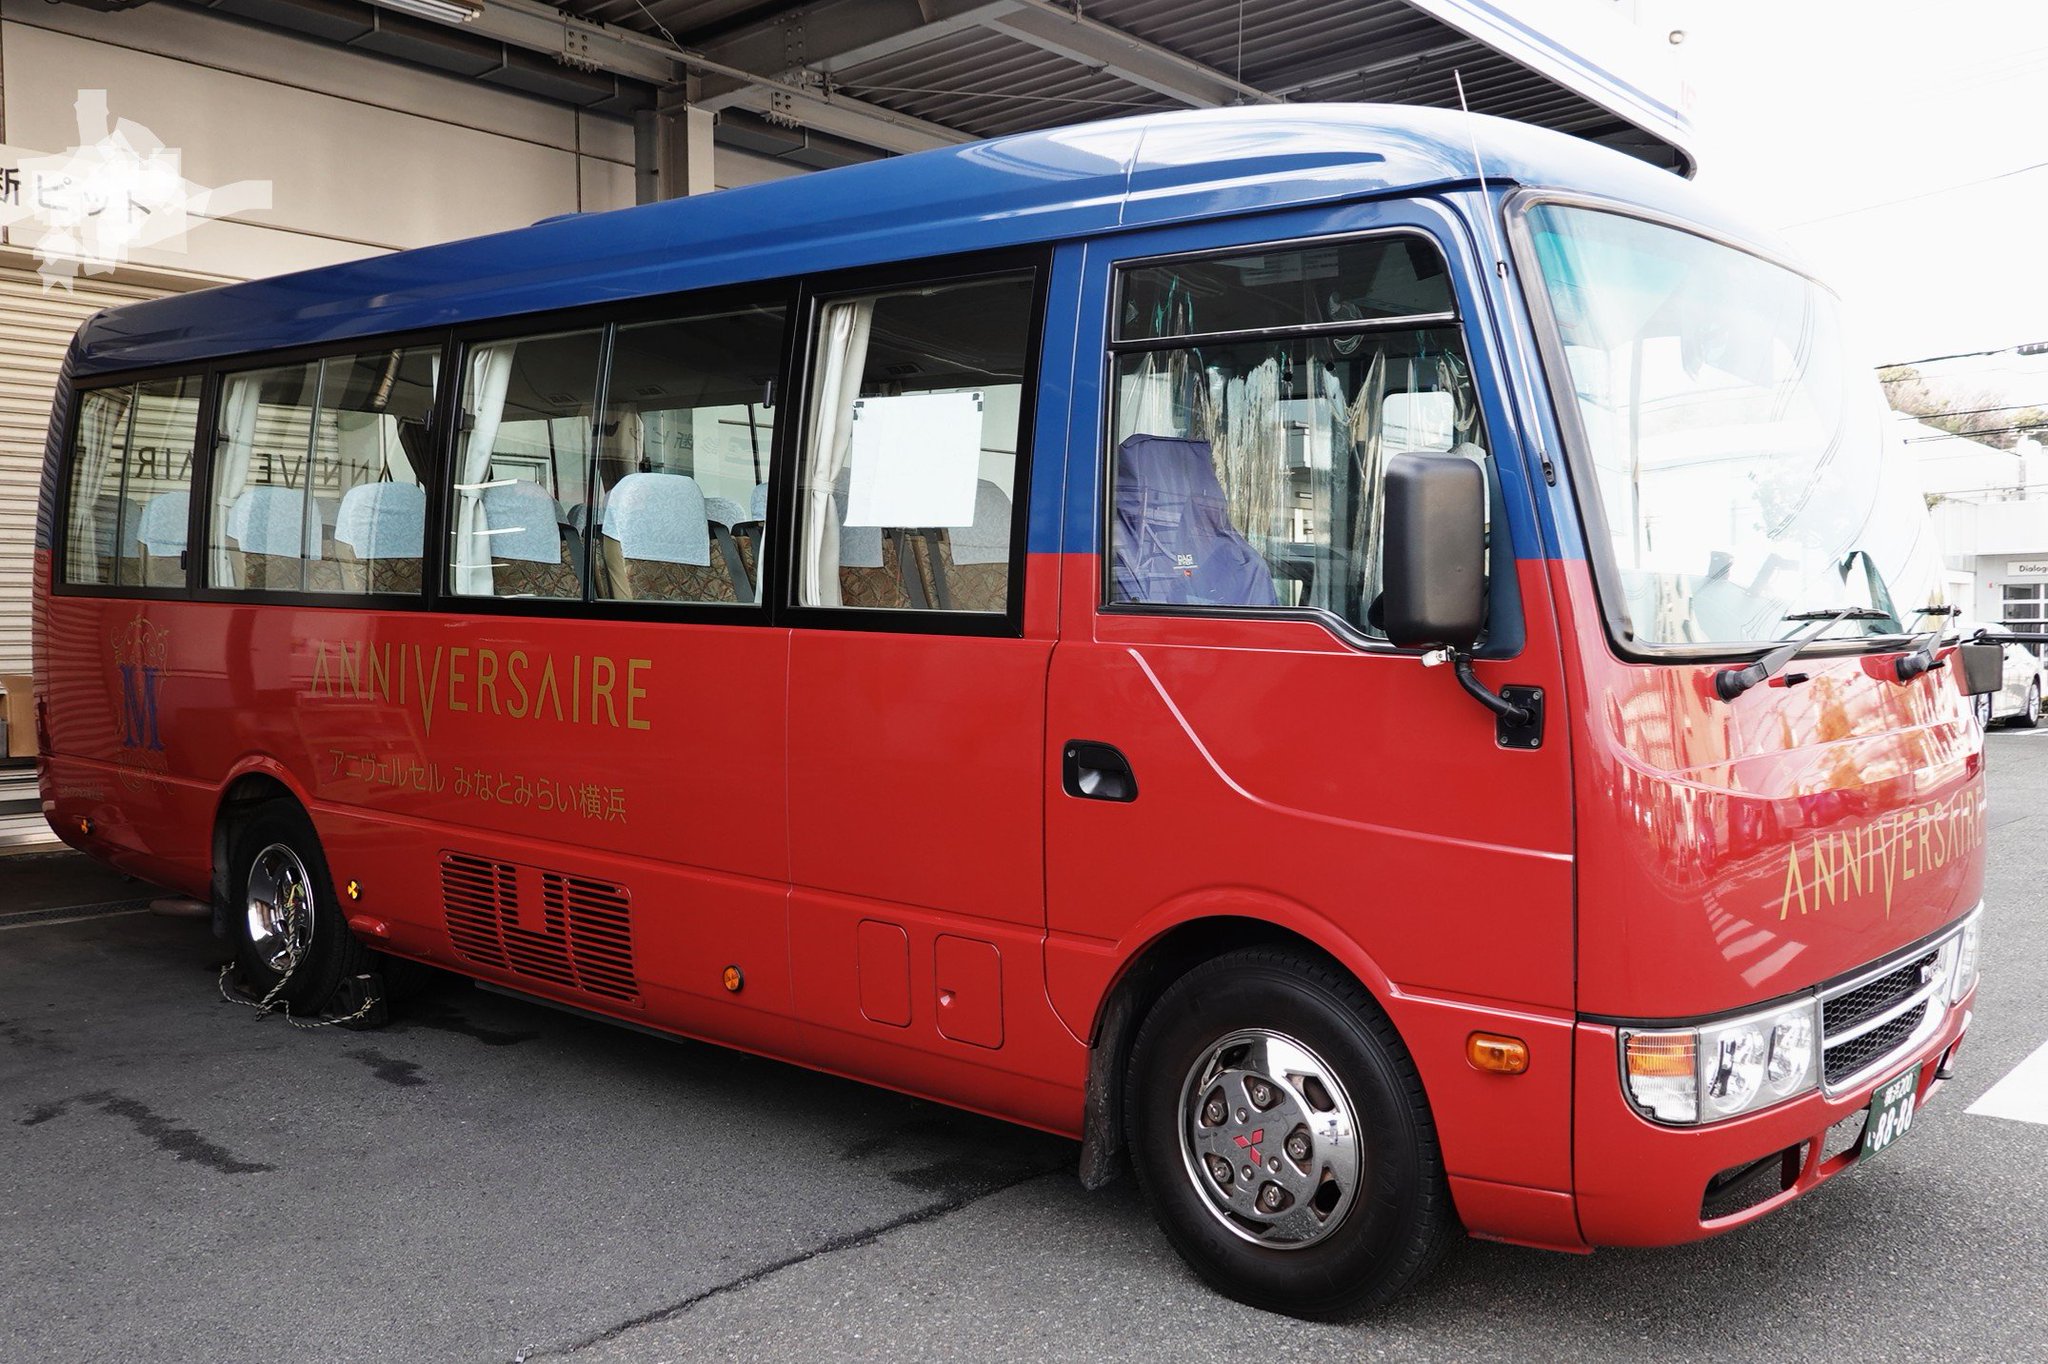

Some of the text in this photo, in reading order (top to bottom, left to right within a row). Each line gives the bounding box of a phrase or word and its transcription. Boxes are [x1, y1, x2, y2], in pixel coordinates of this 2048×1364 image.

[311, 639, 652, 737] ANNIVERSAIRE
[330, 748, 628, 825] アニヴェルセル みなとみらい横浜
[1780, 784, 1984, 921] ANNIVERSAIRE
